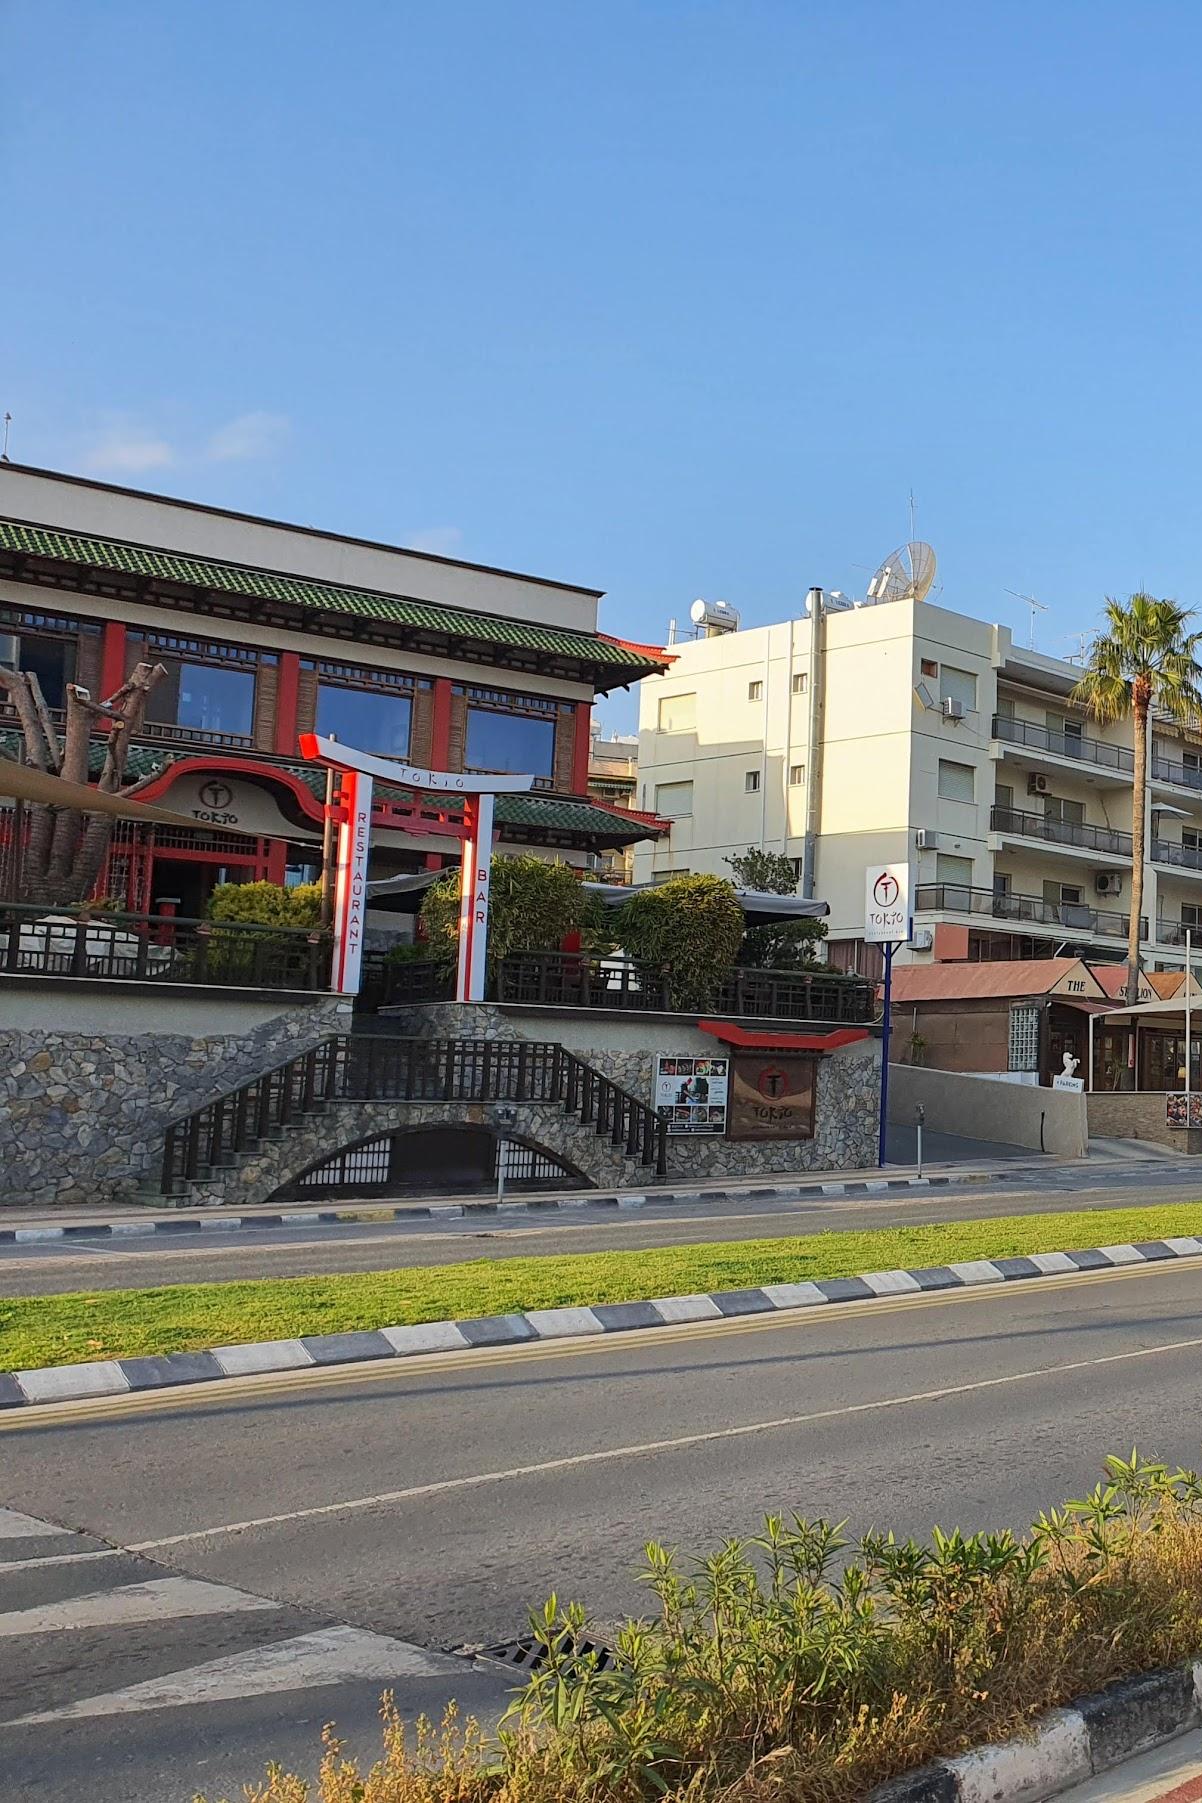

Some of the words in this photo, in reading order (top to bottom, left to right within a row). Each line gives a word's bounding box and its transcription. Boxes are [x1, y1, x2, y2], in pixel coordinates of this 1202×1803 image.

[401, 767, 465, 788] TOKIO
[350, 812, 367, 954] RESTAURANT
[475, 869, 487, 924] BAR
[1067, 980, 1086, 992] THE
